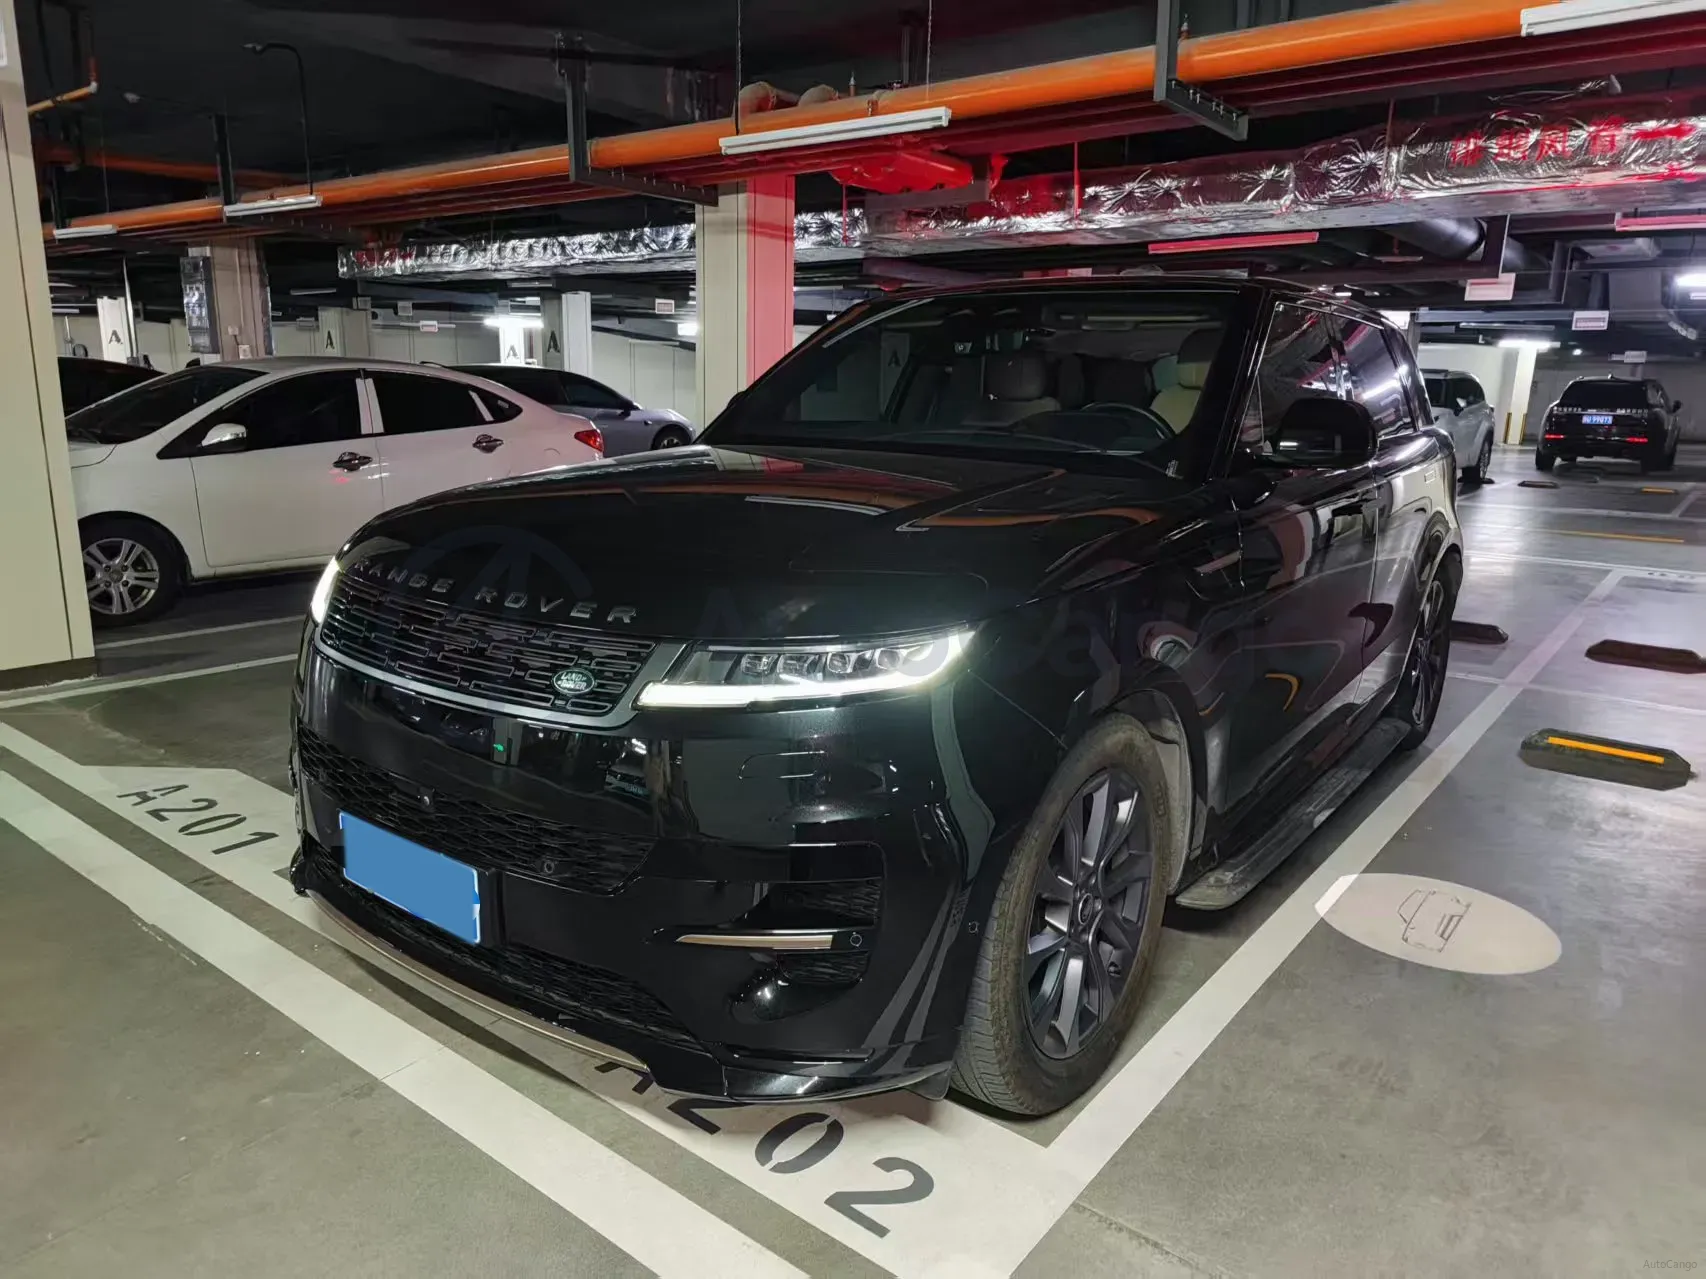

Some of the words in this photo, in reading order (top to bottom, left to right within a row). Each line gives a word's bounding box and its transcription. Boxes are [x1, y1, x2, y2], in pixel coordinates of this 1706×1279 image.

[325, 330, 335, 349] A
[545, 330, 560, 353] A
[354, 554, 454, 593] RANGE
[474, 586, 637, 624] ROVER
[560, 671, 583, 682] LAND
[560, 680, 587, 691] ROVER
[116, 784, 280, 855] A201
